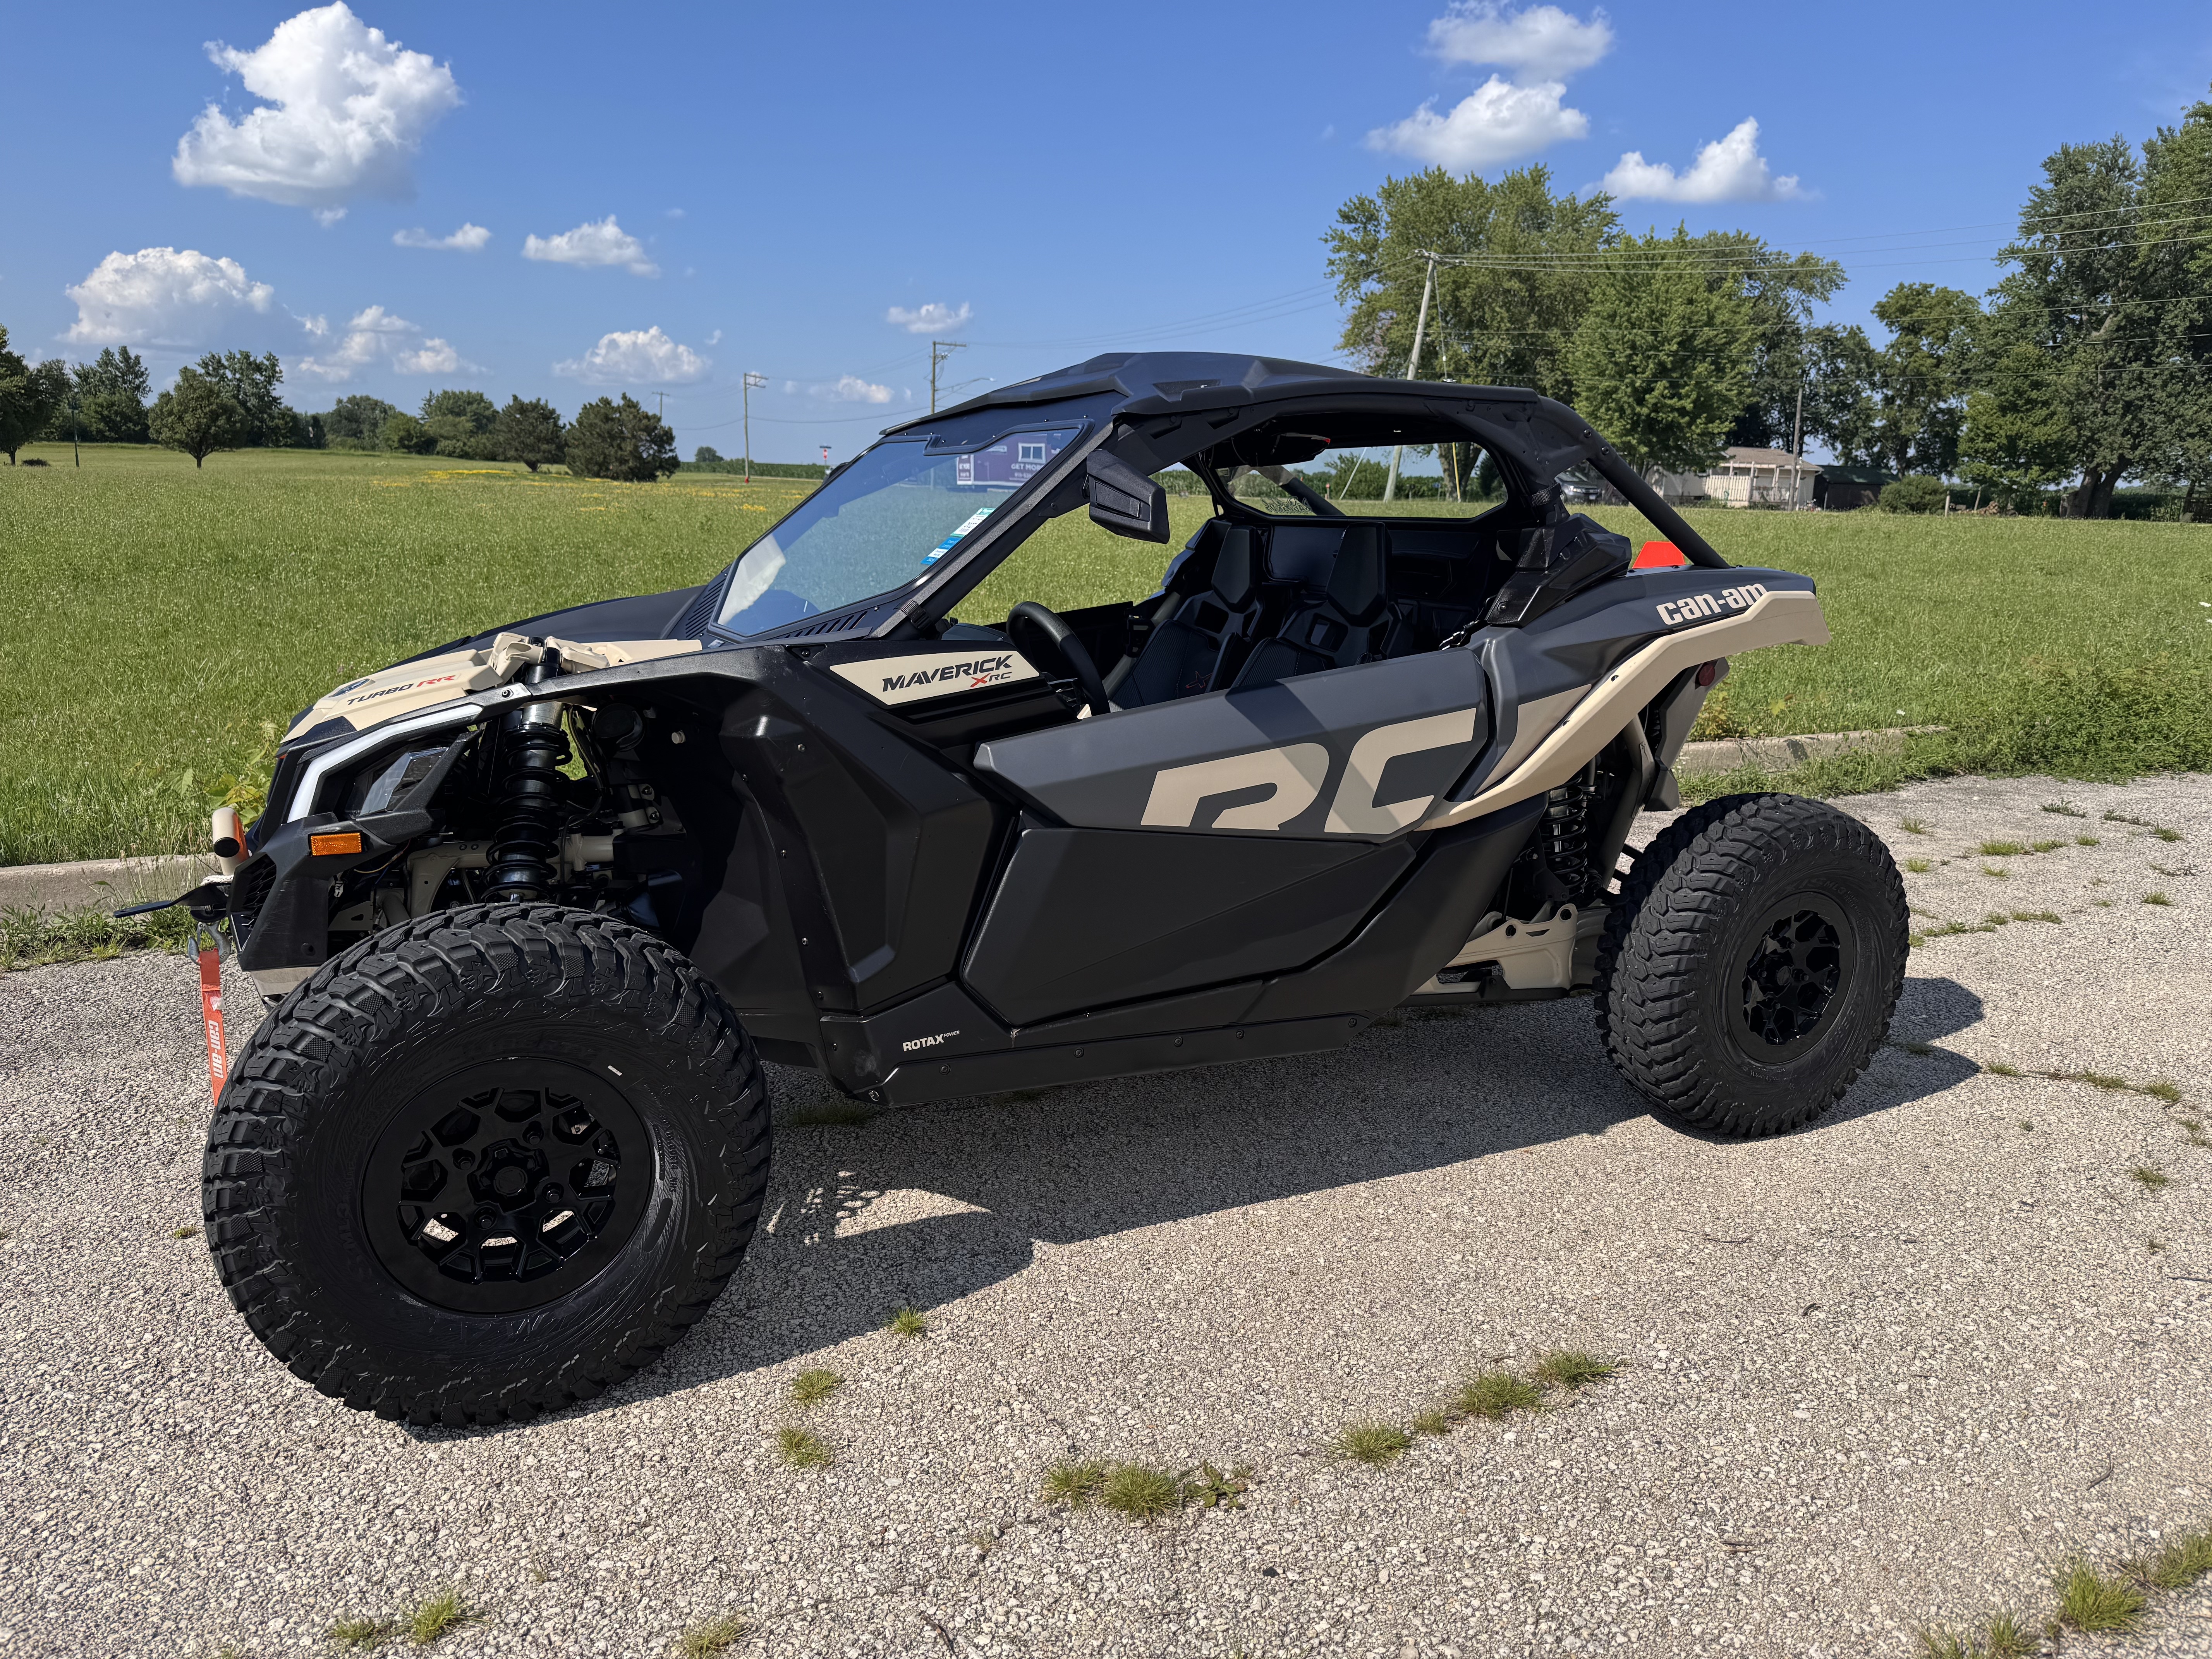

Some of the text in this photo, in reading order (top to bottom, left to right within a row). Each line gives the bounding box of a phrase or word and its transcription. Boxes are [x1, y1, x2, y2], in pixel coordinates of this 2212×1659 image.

[1656, 583, 1767, 625] can-am
[347, 675, 457, 705] TURBO RR
[882, 654, 1013, 692] MAVERICK
[208, 1020, 224, 1079] can-am
[903, 1034, 945, 1052] ROTAX
